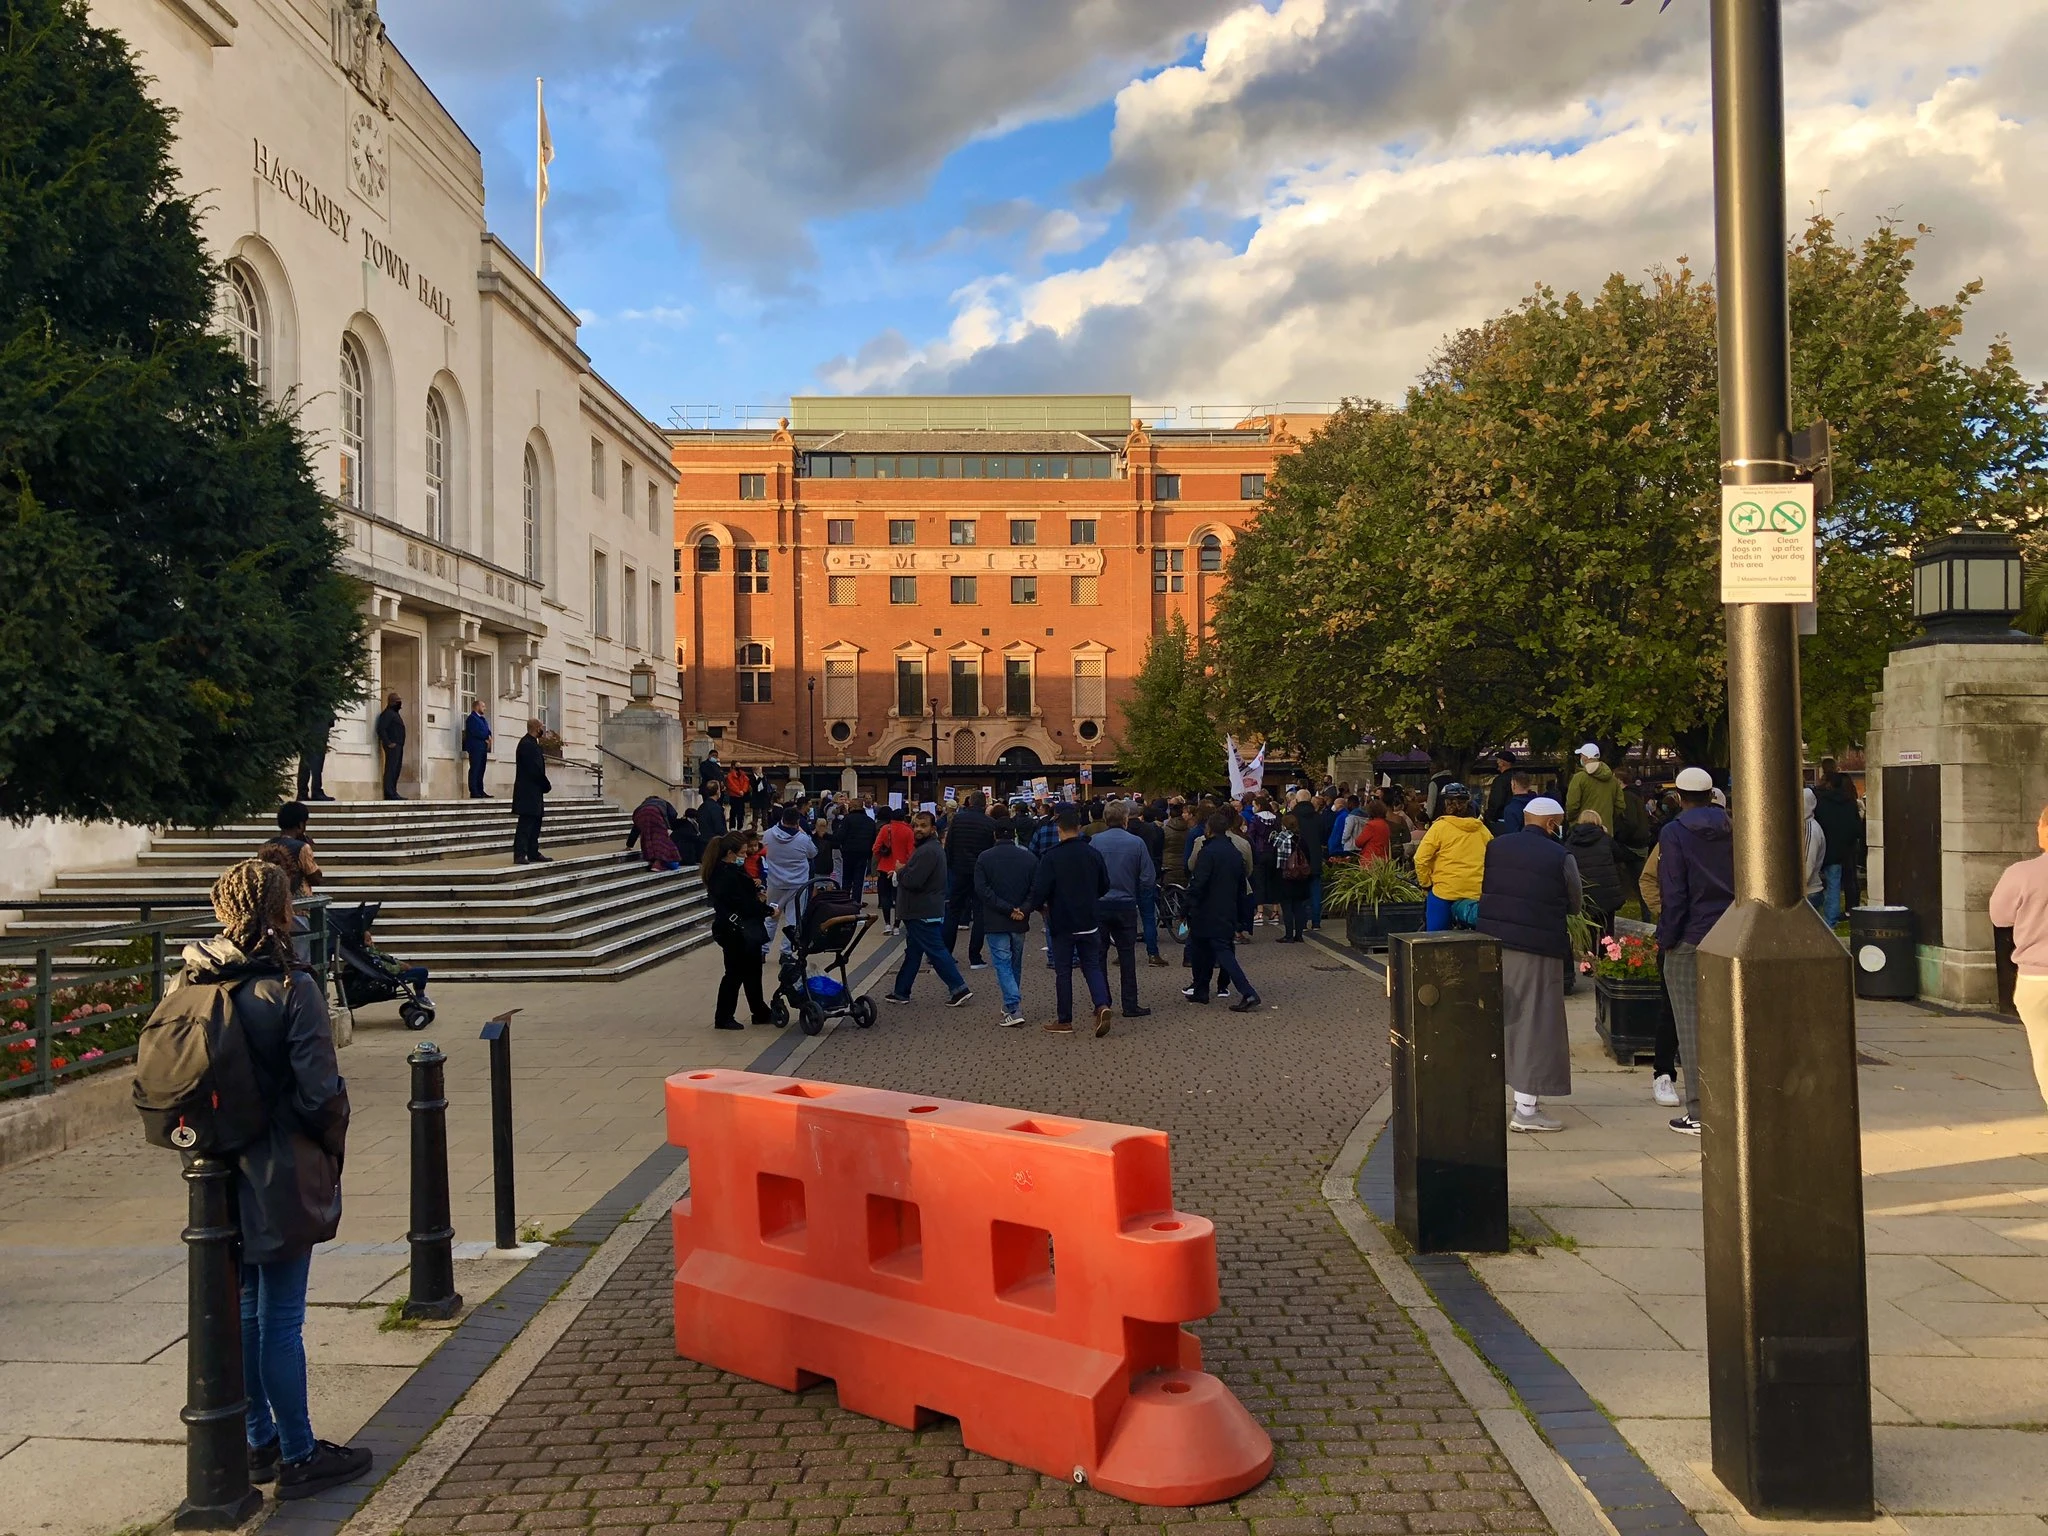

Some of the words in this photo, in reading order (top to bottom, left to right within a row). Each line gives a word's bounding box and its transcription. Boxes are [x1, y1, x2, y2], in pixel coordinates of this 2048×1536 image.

[253, 137, 351, 243] HACKNEY
[361, 227, 410, 290] TOWN
[418, 273, 456, 326] HALL
[1731, 546, 1751, 554] dogs
[844, 553, 1086, 569] EMPIRE
[1790, 553, 1805, 561] dog
